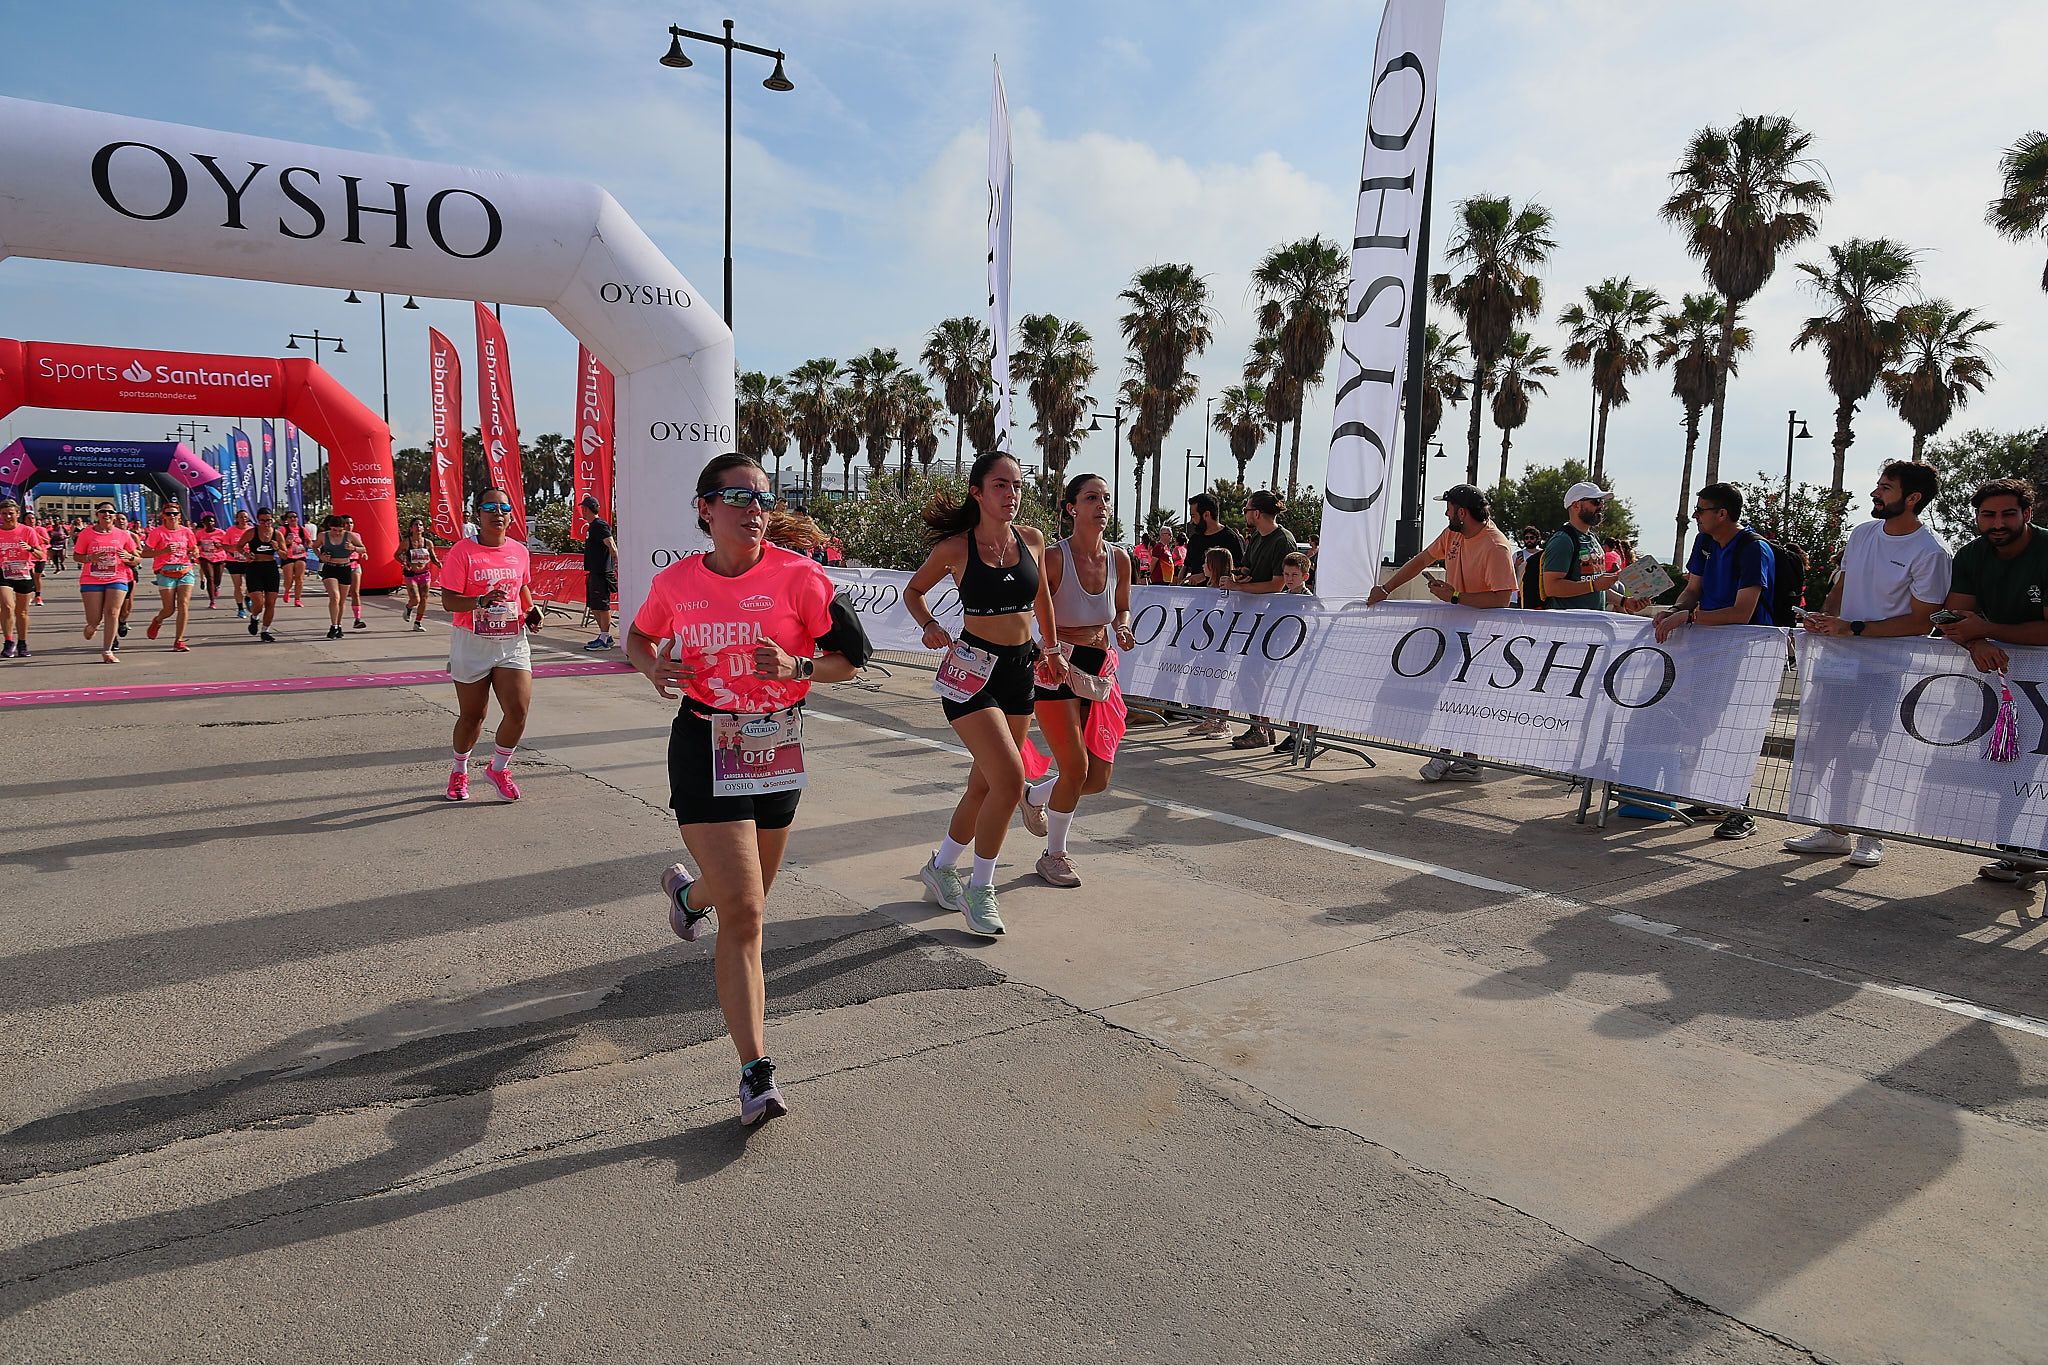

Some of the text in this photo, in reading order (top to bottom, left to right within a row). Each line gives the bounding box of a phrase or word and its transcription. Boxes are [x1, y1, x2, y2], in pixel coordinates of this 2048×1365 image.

[92, 141, 502, 259] OYSHO
[1325, 51, 1426, 512] OYSHO
[600, 282, 692, 308] OYSHO
[39, 358, 272, 388] Sports Santander
[119, 390, 197, 401] sportssantander.es
[650, 421, 731, 443] OYSHO
[352, 461, 382, 473] Sports
[350, 476, 392, 485] Santander
[474, 568, 518, 581] CARRERA
[489, 620, 507, 628] 016
[1132, 604, 1307, 661] OYSHO
[682, 622, 763, 647] CARRERA
[948, 665, 968, 681] 016
[1158, 661, 1236, 680] WWW.OYSHO.COM
[1391, 627, 1676, 708] OYSHO
[1439, 700, 1569, 732] WWW.OYSHO.COM
[743, 748, 776, 763] 016
[774, 767, 796, 776] VALENCIA
[724, 778, 797, 791] OYSHO Santander
